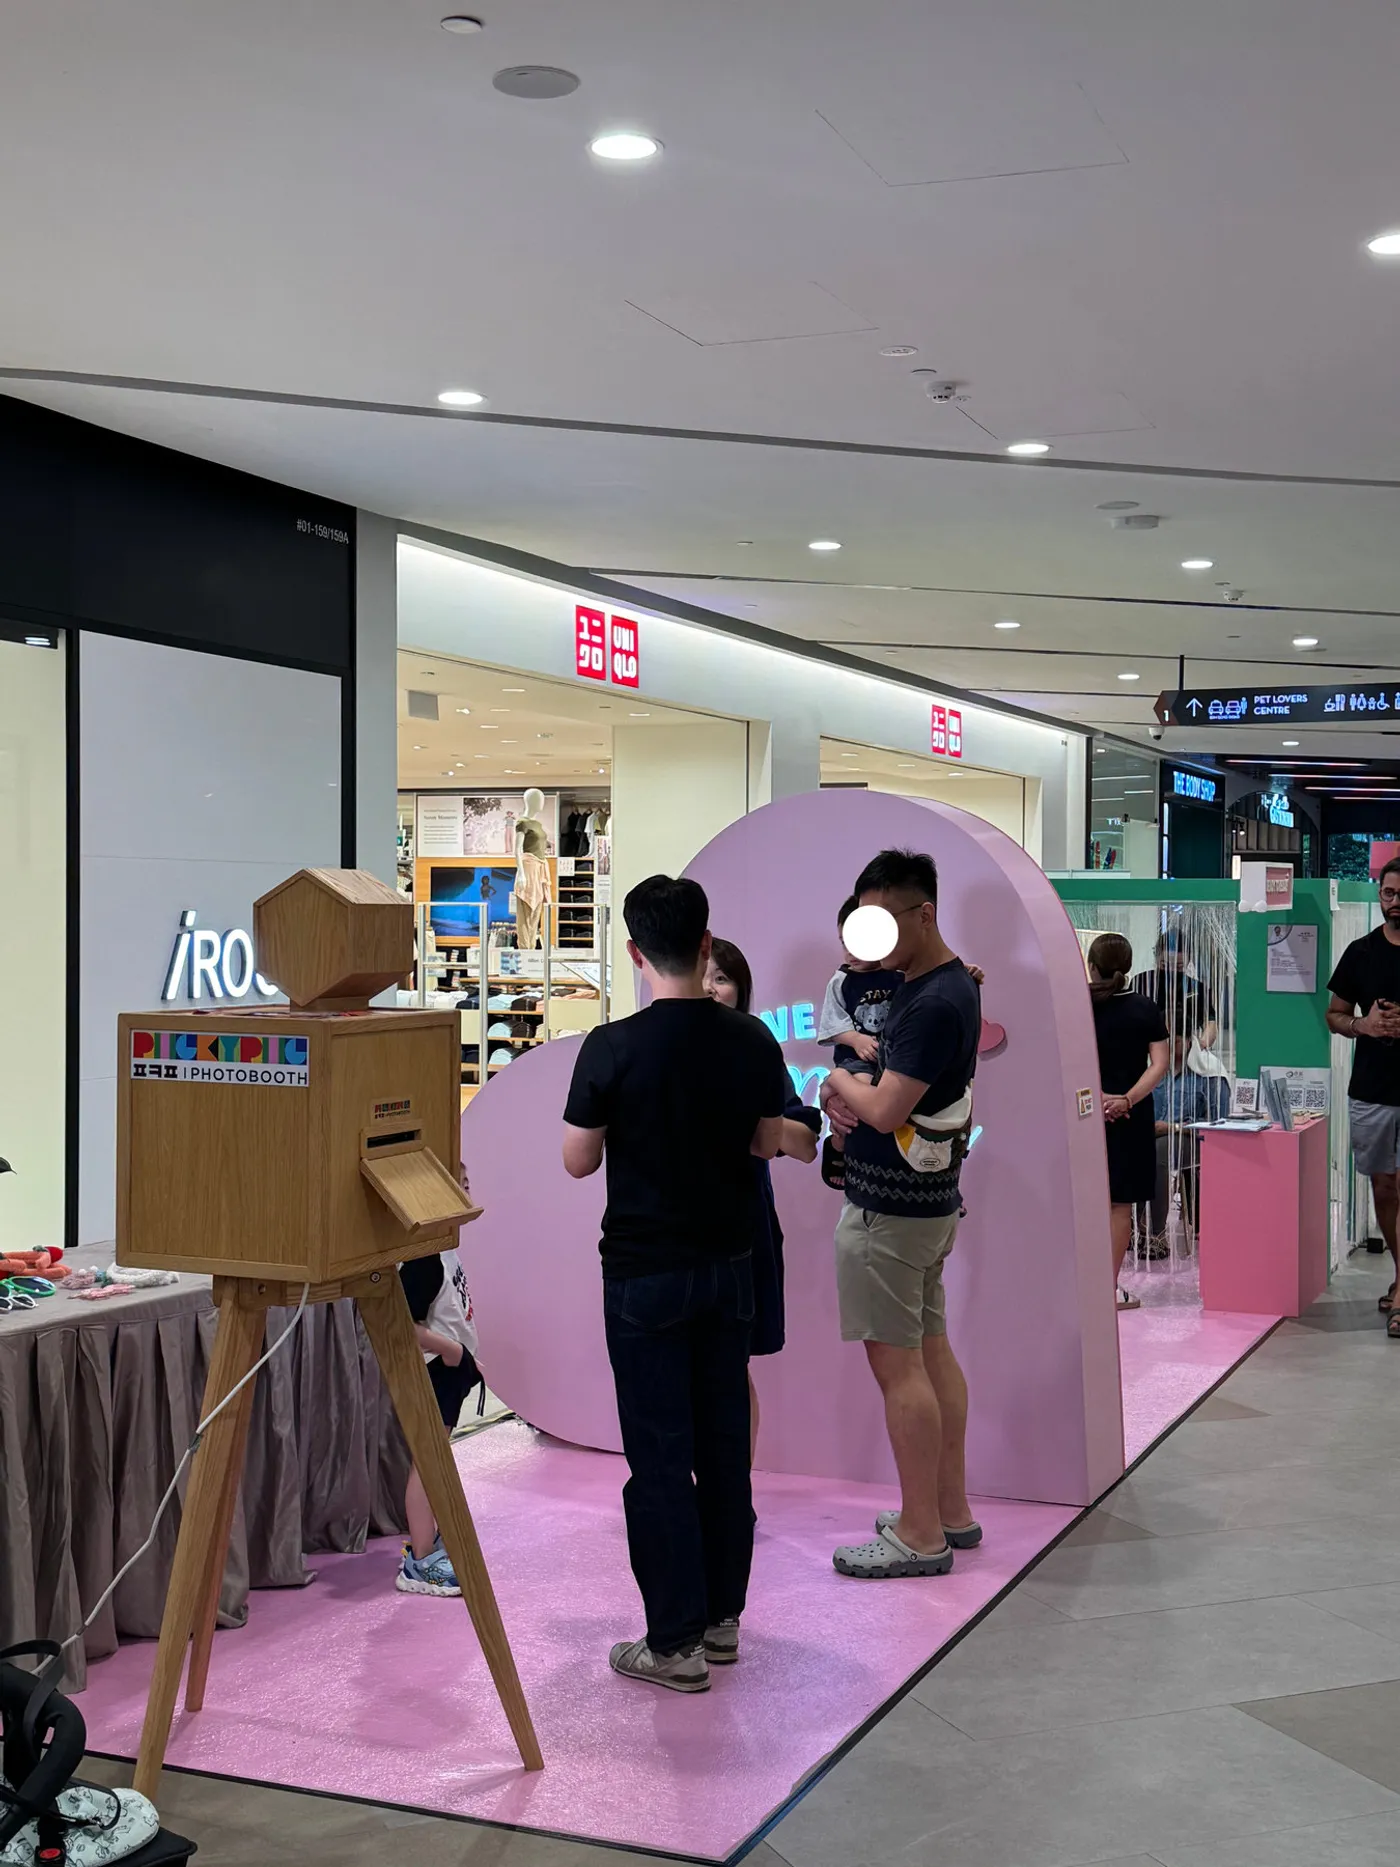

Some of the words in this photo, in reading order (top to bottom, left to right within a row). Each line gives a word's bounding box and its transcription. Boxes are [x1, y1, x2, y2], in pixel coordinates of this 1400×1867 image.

[296, 518, 349, 544] #01-159/159A
[613, 625, 635, 652] UNI
[613, 652, 638, 680] QLO
[1253, 695, 1271, 704] PET
[1272, 694, 1308, 703] LOVERS
[1163, 709, 1169, 722] 1
[1253, 706, 1290, 715] CENTRE
[132, 1031, 308, 1066] PICKYPIC
[190, 1067, 308, 1085] PHOTOBOOTH
